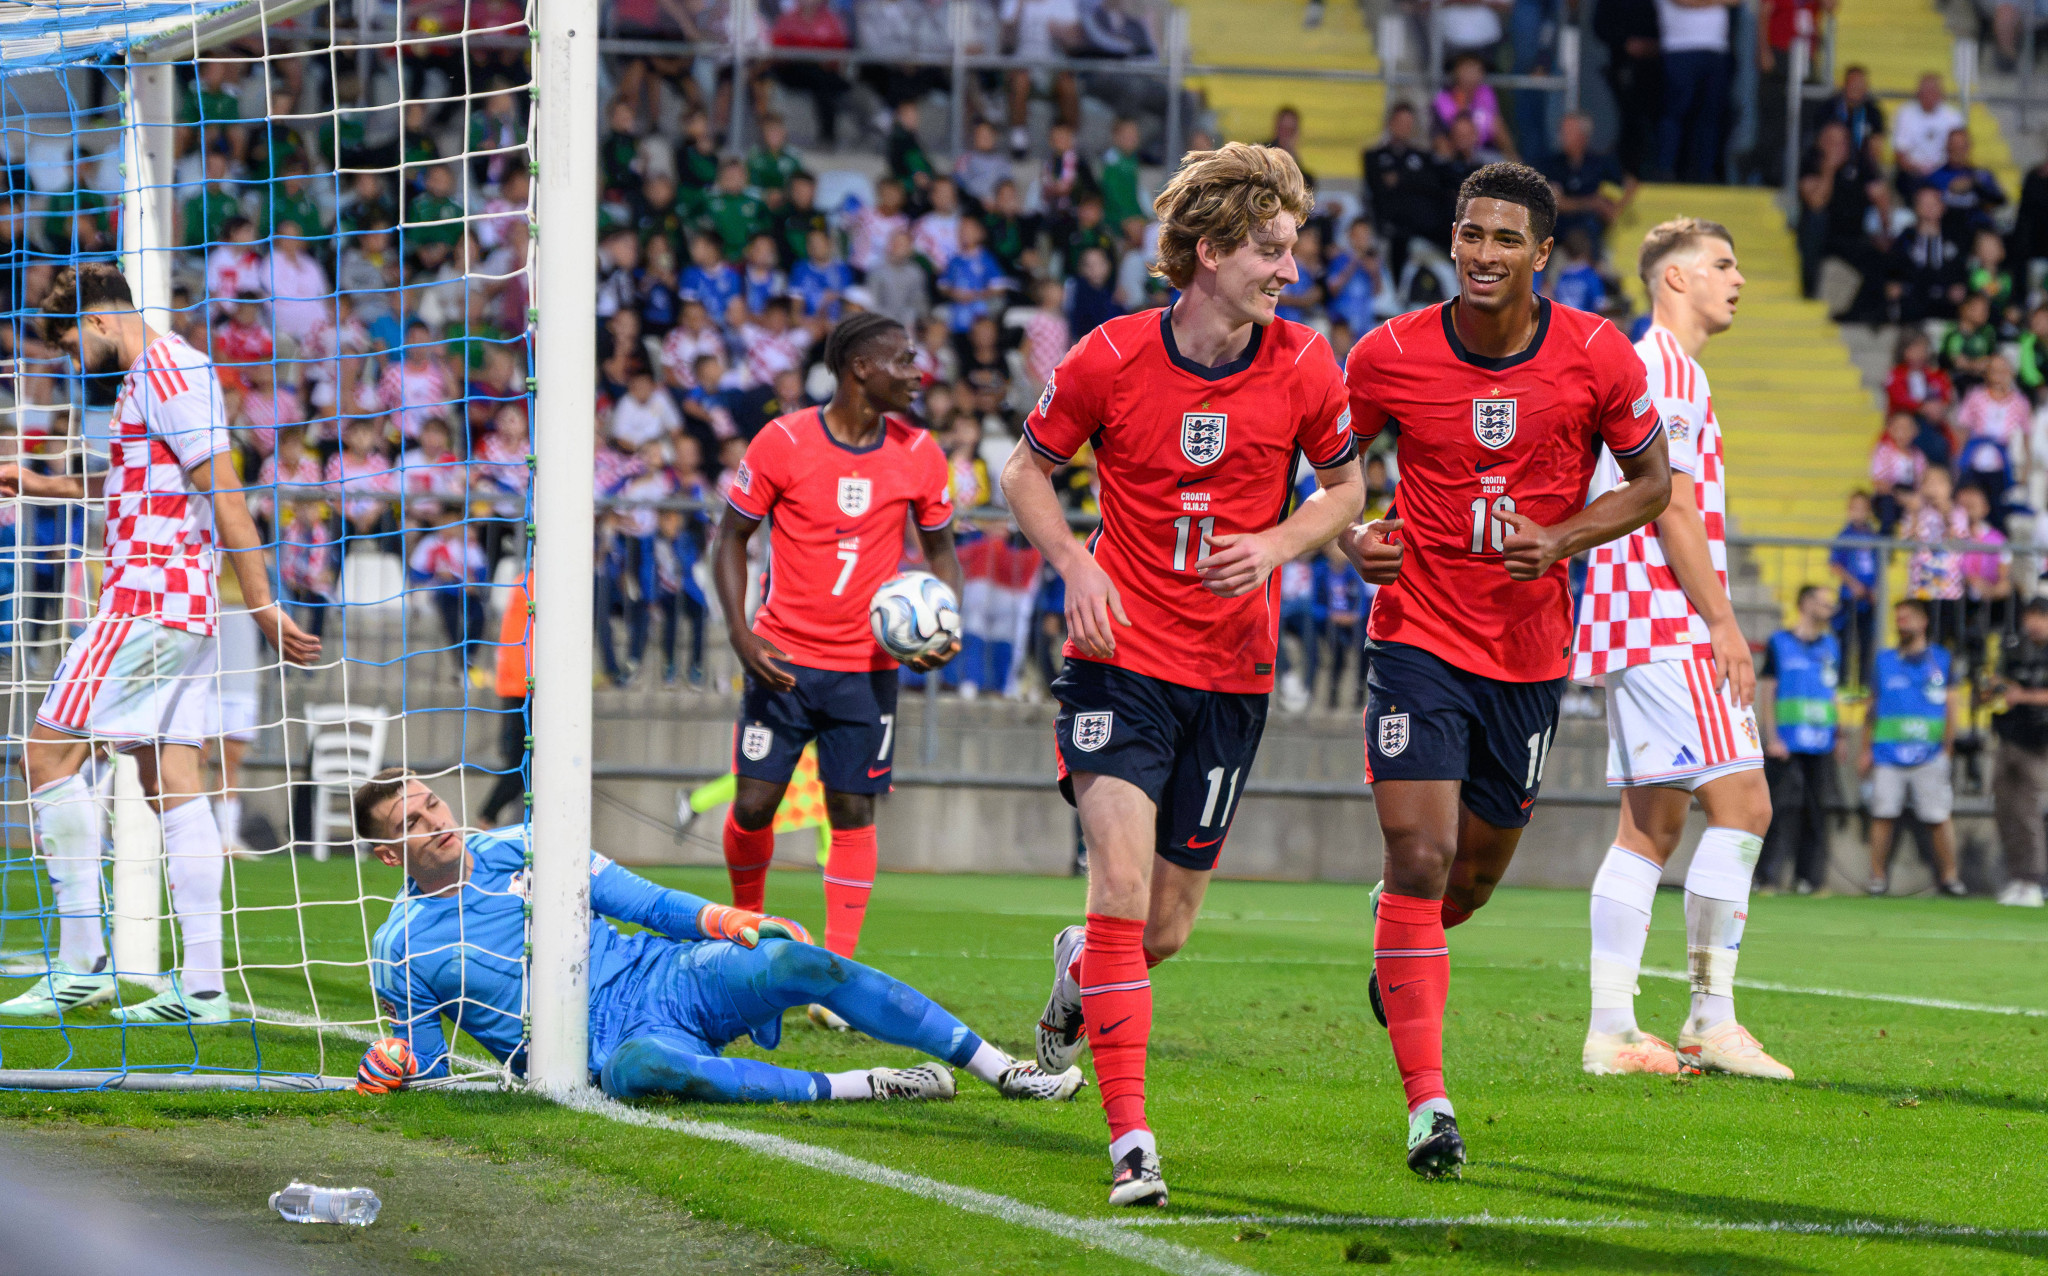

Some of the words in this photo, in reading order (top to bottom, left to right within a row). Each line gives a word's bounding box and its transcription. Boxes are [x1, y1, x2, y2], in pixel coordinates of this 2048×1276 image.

[1180, 492, 1211, 502] CROATIA
[1173, 516, 1215, 572] 11
[1471, 495, 1516, 553] 10
[831, 551, 859, 596] 7
[877, 714, 893, 761] 7
[1199, 766, 1241, 828] 11
